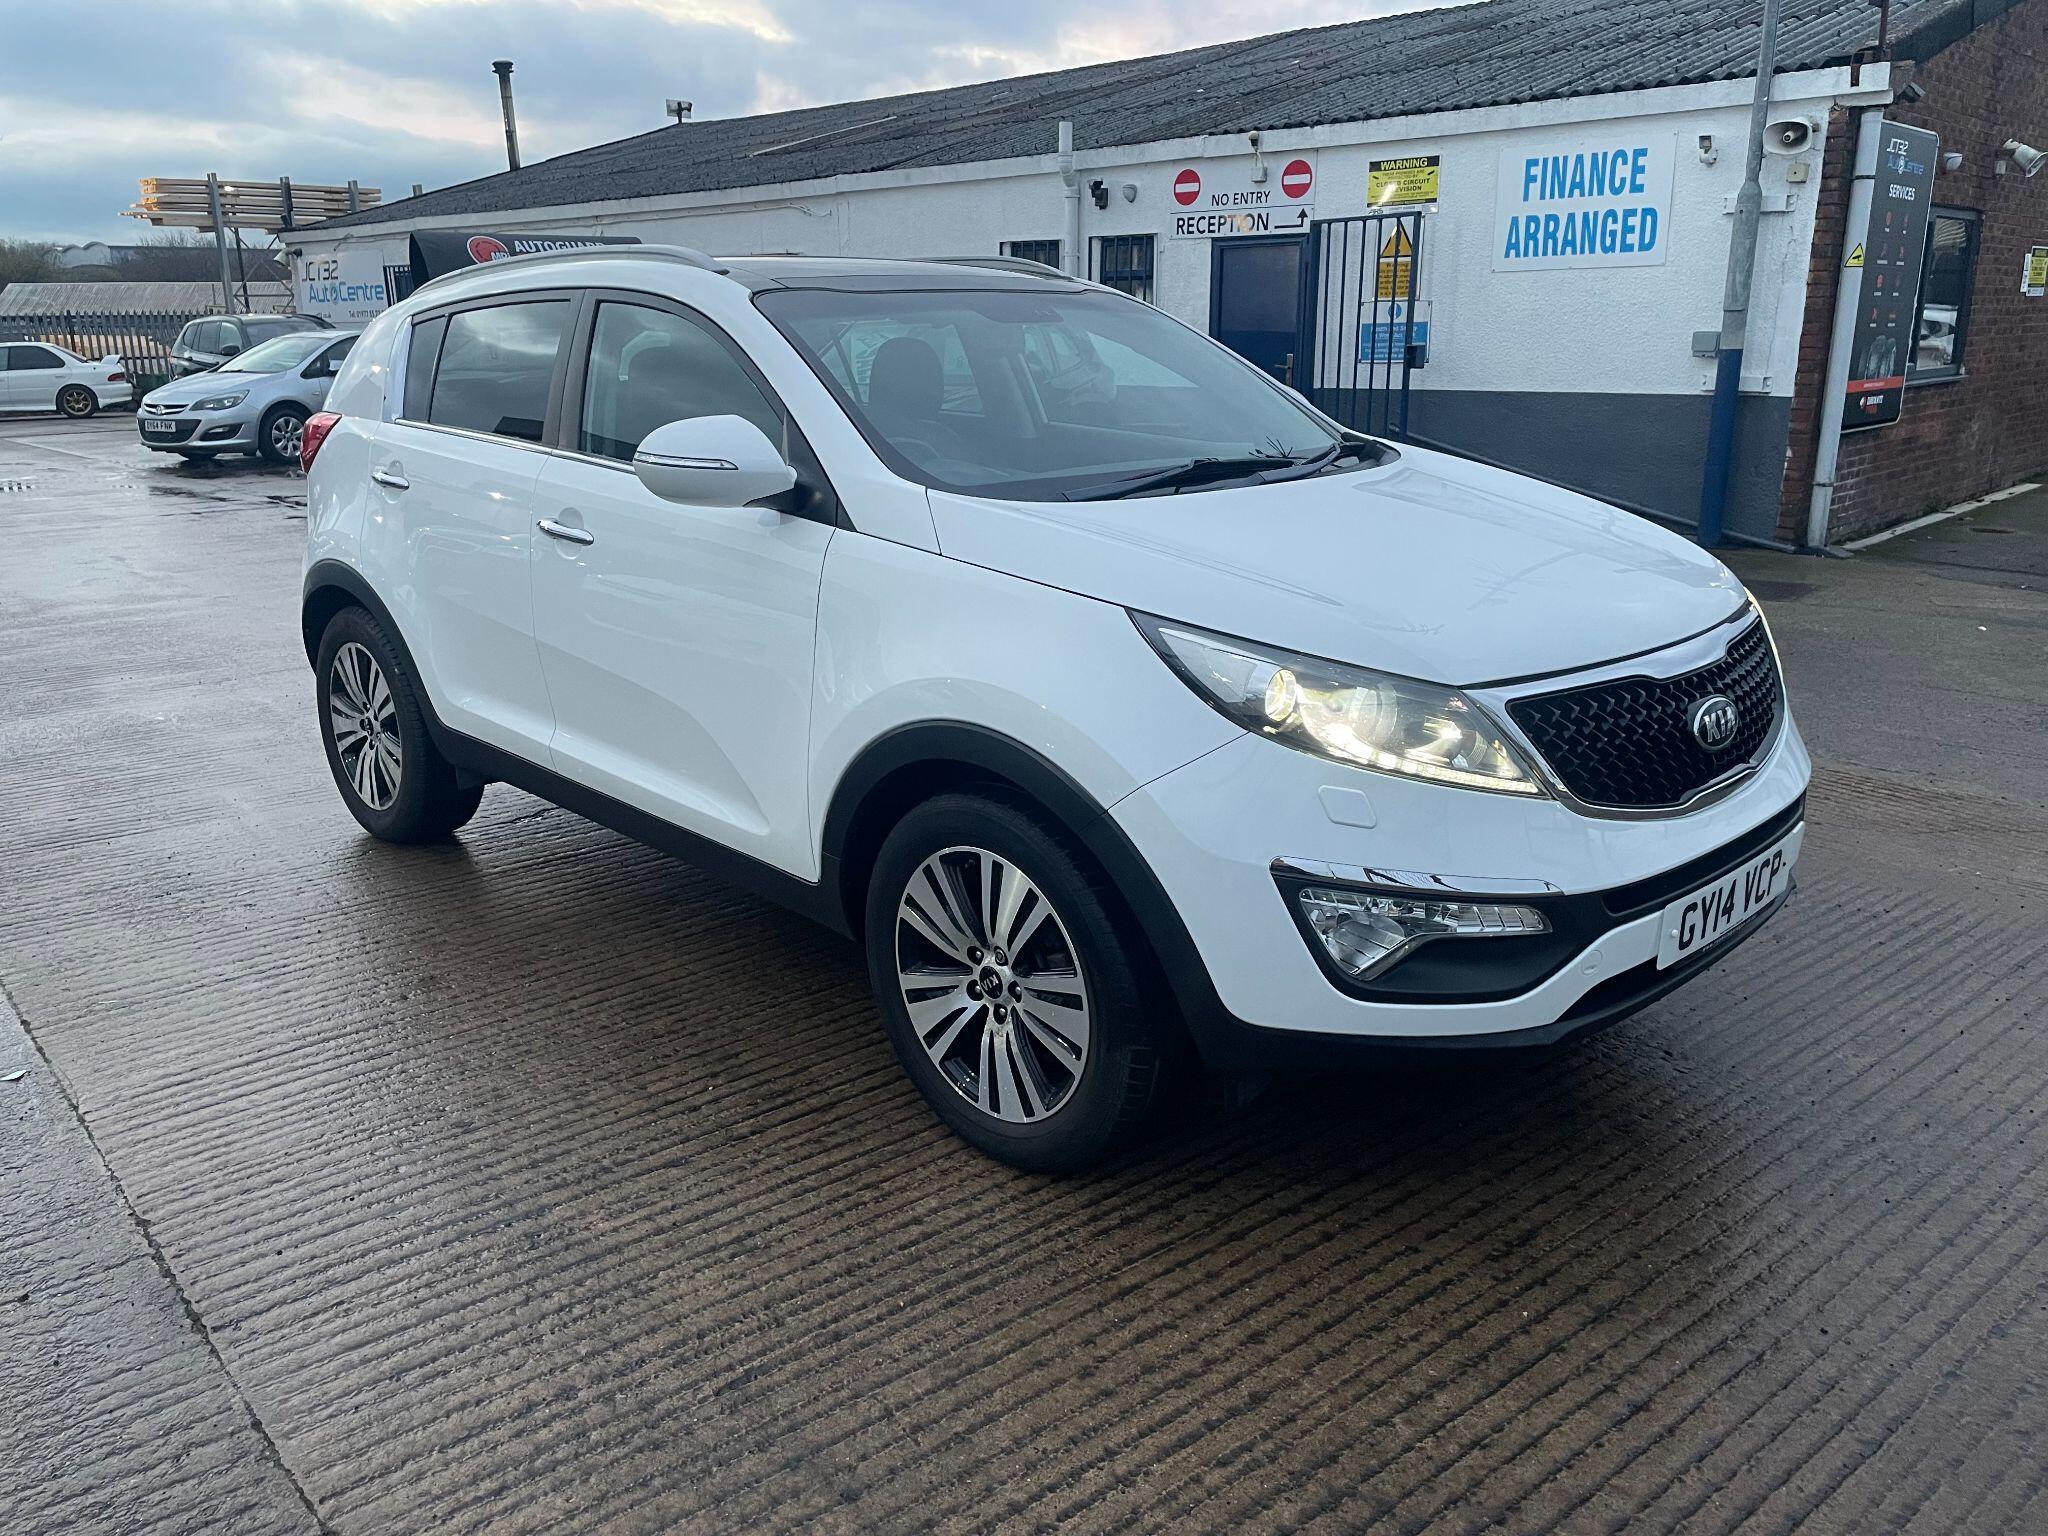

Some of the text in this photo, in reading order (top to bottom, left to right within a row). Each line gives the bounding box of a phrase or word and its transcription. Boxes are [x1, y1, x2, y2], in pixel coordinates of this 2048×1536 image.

[1380, 157, 1428, 171] WARNING
[1522, 147, 1649, 202] FINANCE
[1403, 177, 1431, 186] CIRCUIT
[1889, 183, 1915, 201] SERVICES
[1211, 190, 1271, 207] NO ENTRY
[1176, 212, 1270, 235] RECEPTION
[1504, 207, 1658, 258] ARRANGED
[1703, 706, 1736, 743] KIA
[1677, 878, 1738, 951] GY14
[1743, 848, 1784, 913] VCP
